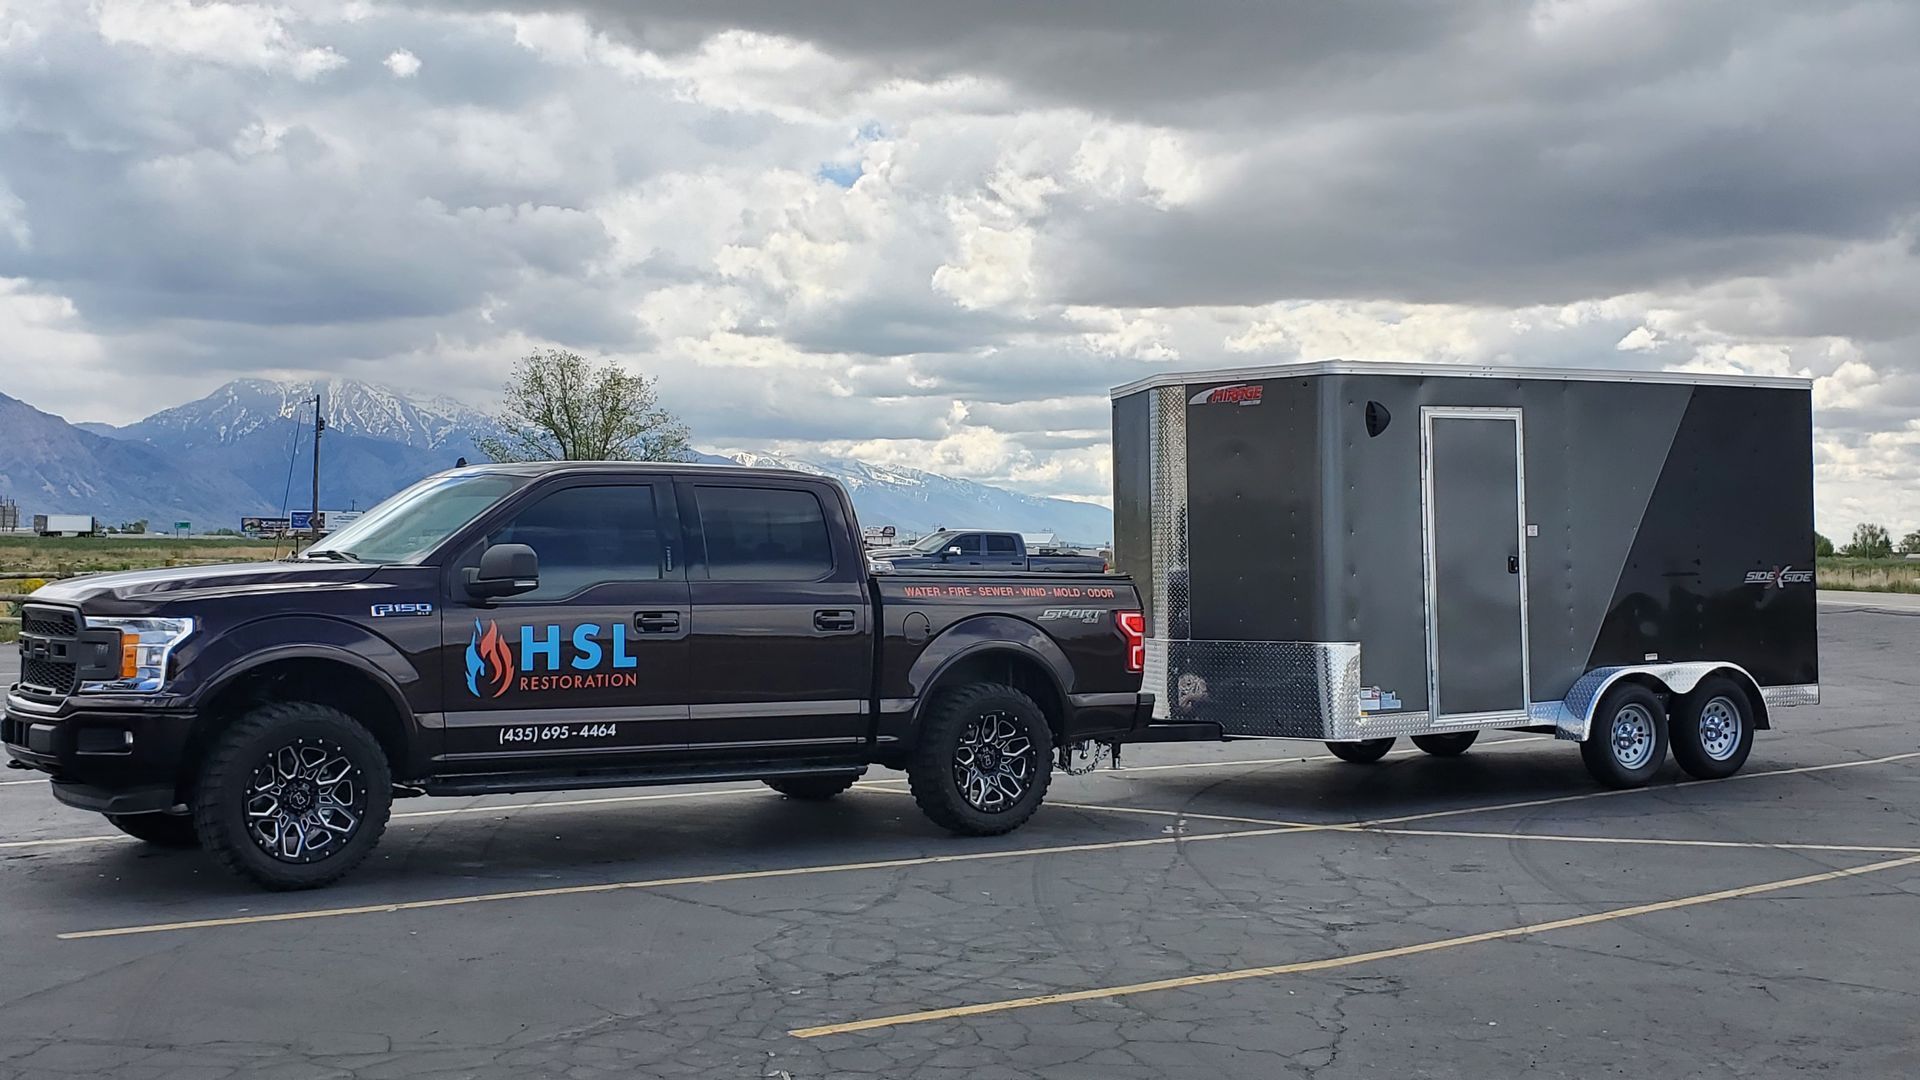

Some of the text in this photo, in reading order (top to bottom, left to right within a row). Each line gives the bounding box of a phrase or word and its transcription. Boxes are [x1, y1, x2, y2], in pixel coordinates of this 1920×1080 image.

[1211, 386, 1263, 403] MIRAGE
[1745, 571, 1776, 580] SIDE
[1782, 574, 1813, 582] SIDE
[904, 586, 1115, 598] WATER FIRE SEWER WIND MOLD ODOR
[1037, 609, 1107, 621] SPORT
[521, 623, 638, 671] HSL
[520, 672, 637, 691] RESTORATION
[499, 726, 538, 745] (435)
